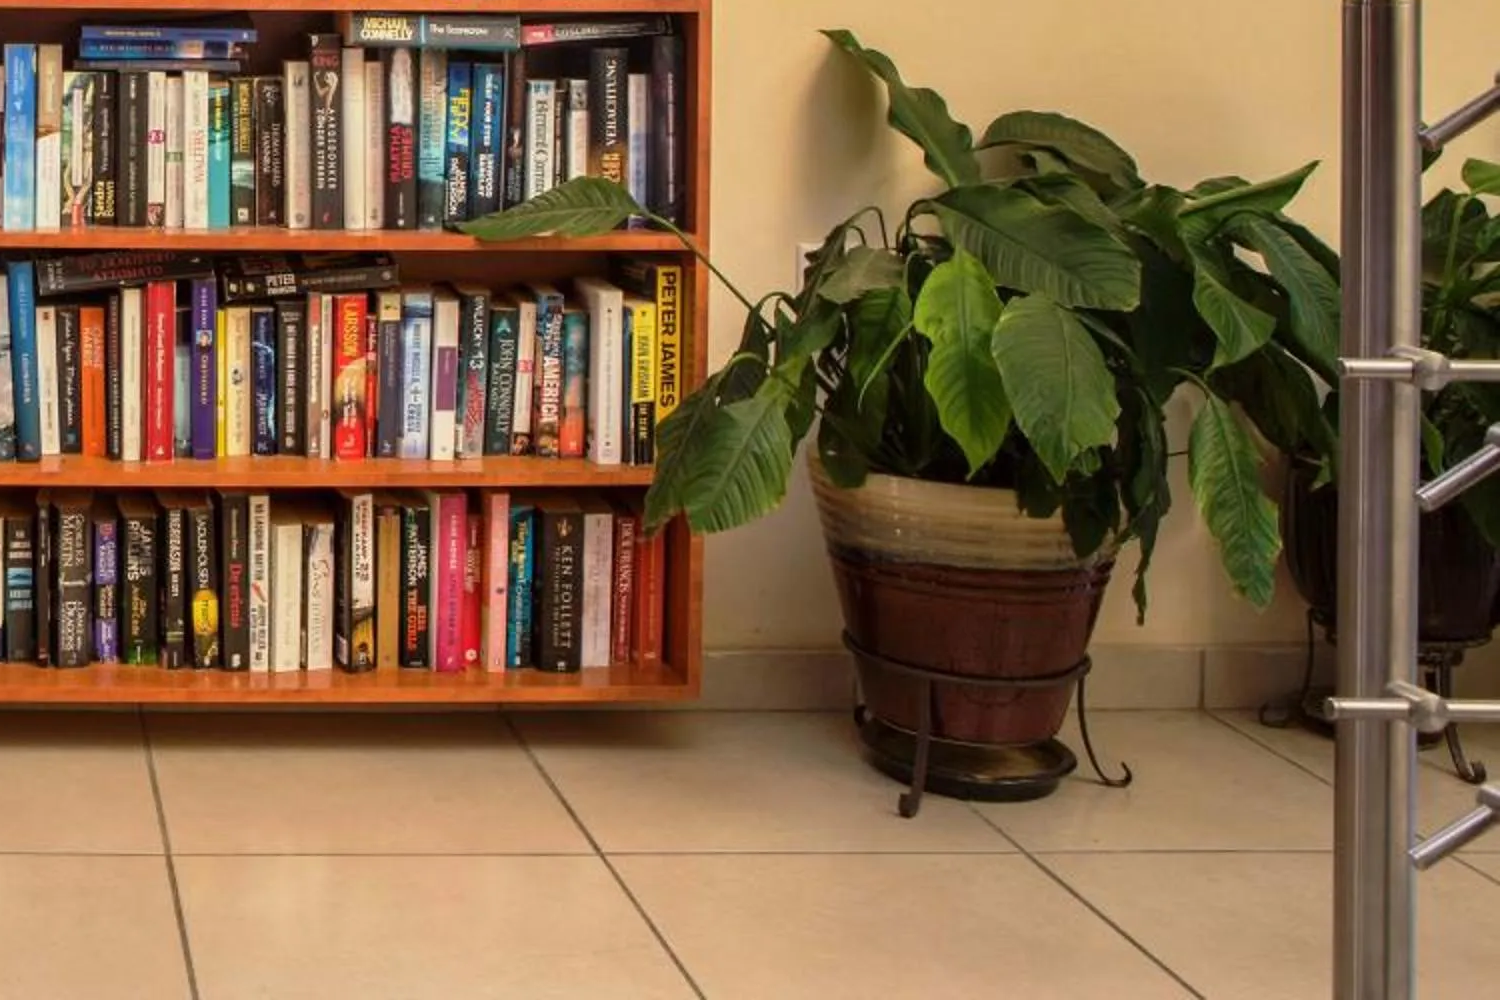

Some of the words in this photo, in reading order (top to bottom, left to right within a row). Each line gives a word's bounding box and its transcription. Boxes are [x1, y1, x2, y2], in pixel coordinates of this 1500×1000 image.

[359, 29, 414, 42] CONNELLY
[363, 16, 408, 30] MICHAEL
[429, 23, 445, 35] The
[605, 59, 618, 146] VERACHTUNG
[389, 125, 400, 184] MARTHA
[401, 127, 413, 178] GRIMES
[94, 180, 104, 217] Sandra
[104, 180, 115, 217] Brown
[449, 157, 458, 216] PATTERSON
[458, 170, 467, 203] JAMES
[265, 273, 296, 286] PETER
[472, 295, 485, 347] UNLUCKY
[661, 270, 677, 336] PETER
[343, 301, 359, 356] LARSSON
[469, 350, 484, 370] 13
[498, 338, 515, 369] JOHN
[540, 356, 560, 424] AMERICA
[660, 341, 677, 408] JAMES
[496, 373, 514, 435] CONNOLLY
[61, 514, 75, 568] MARTIN
[75, 512, 85, 549] GEORGE
[255, 516, 264, 551] LAUGHING
[621, 522, 633, 547] DICK
[99, 544, 107, 579] KNIGHT
[127, 520, 139, 581] ROLLINS
[140, 525, 153, 577] JAMES
[255, 553, 264, 581] MATTER
[407, 524, 417, 586] PATTERSON
[417, 543, 427, 578] JAMES
[553, 547, 561, 562] THE
[561, 545, 573, 575] KEN
[619, 549, 633, 593] FRANCIS
[407, 589, 417, 614] THE
[417, 604, 427, 632] KISS
[560, 583, 572, 649] FOLLETT
[65, 601, 77, 652] DRAGONS
[76, 607, 86, 635] DANCE
[407, 616, 417, 651] GIRLS
